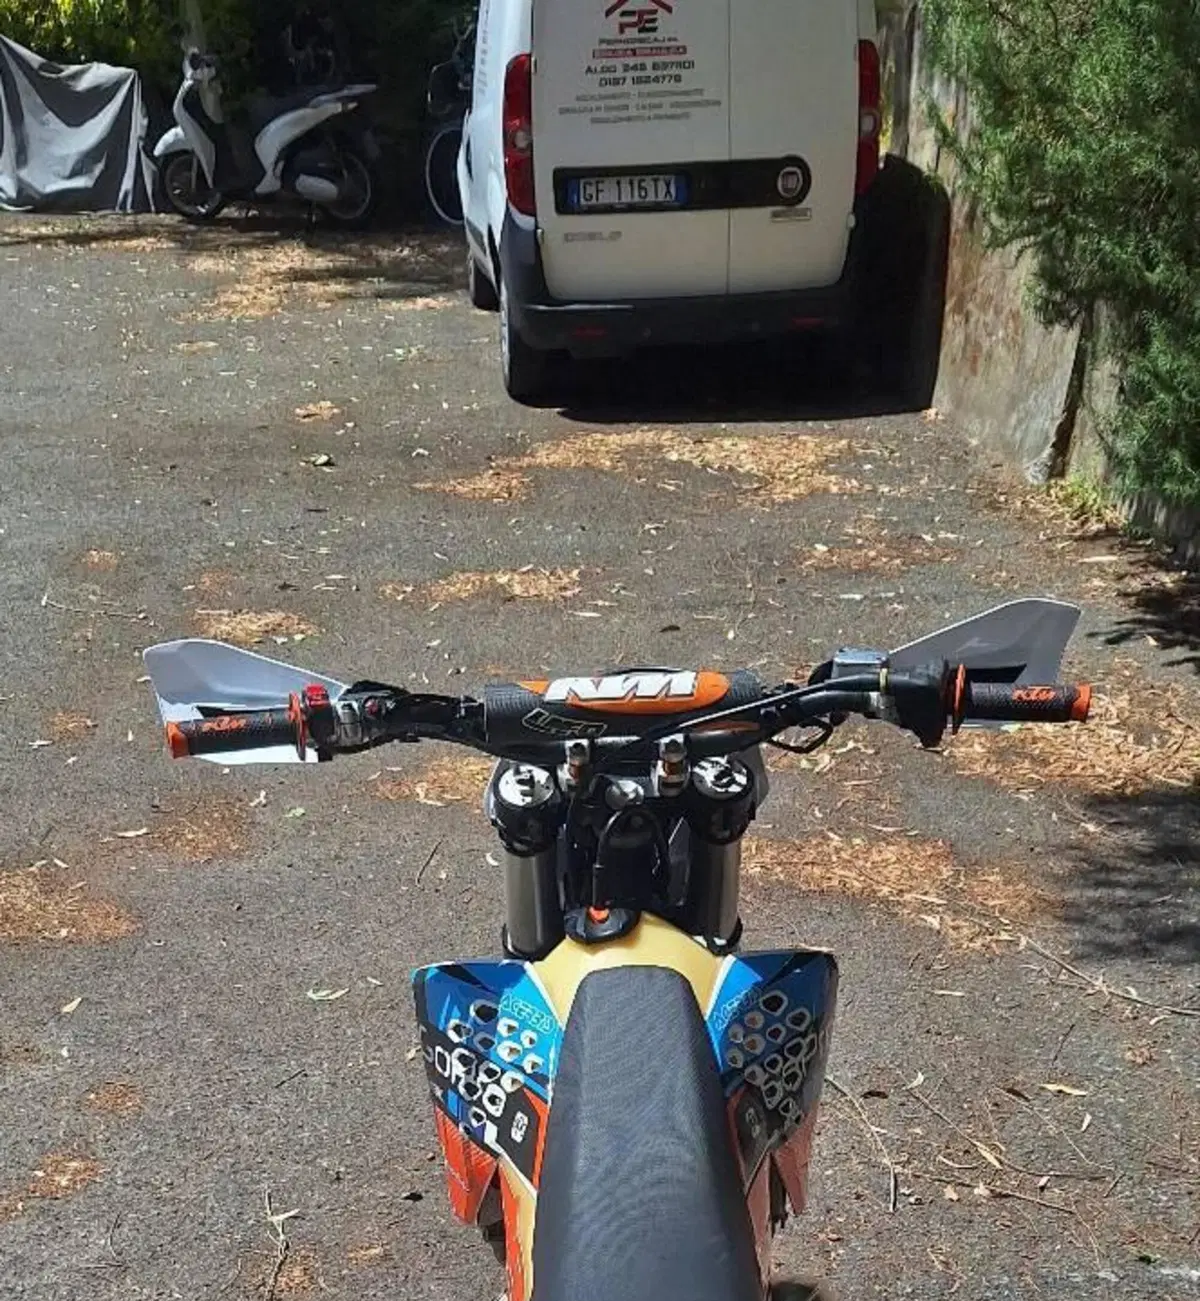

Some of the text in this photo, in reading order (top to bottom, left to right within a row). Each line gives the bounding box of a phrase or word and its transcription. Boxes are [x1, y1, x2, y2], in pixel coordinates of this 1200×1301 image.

[582, 175, 674, 203] GF 116TX
[545, 670, 697, 702] KTM
